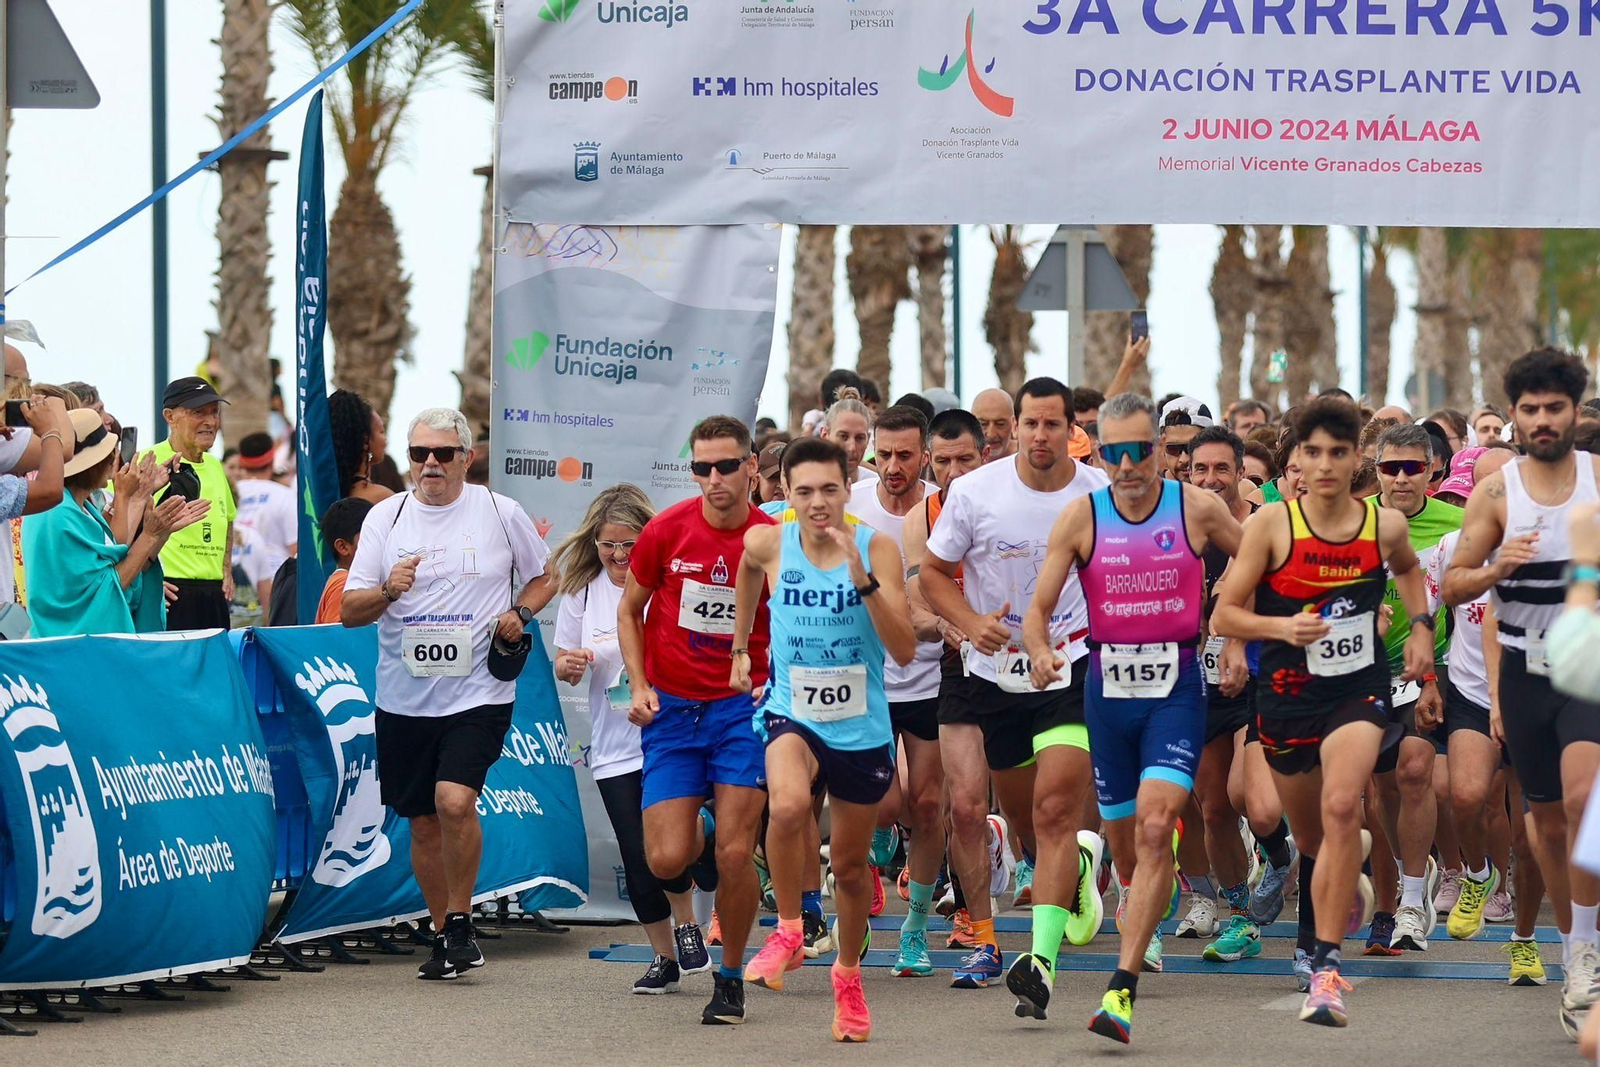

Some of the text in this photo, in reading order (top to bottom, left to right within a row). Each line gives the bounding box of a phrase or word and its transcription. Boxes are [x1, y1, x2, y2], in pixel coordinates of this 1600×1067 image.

[597, 0, 689, 28] Unicaja
[740, 5, 815, 14] Junta de Andalucía
[849, 9, 894, 17] FUNDACIÓN
[1141, 0, 1509, 36] CARRERA
[849, 16, 894, 30] persán
[549, 71, 595, 80] www.tiendas
[1074, 61, 1581, 95] DONACIÓN TRASPLANTE VIDA
[743, 77, 879, 101] hm hospitales
[949, 126, 991, 135] Asociación
[1163, 114, 1480, 143] 2 JUNIO 2024 MÁLAGA
[922, 139, 1019, 149] Donación Trasplante Vida
[610, 151, 684, 163] Ayuntamiento
[763, 152, 837, 161] Puerto de Málaga
[936, 151, 1004, 159] Vicente Granados
[610, 164, 664, 177] de Málaga
[1158, 155, 1483, 174] Memorial Vicente Granados Cabezas
[556, 333, 673, 362] Fundación
[554, 356, 638, 385] Unicaja
[693, 383, 731, 397] persán
[532, 411, 614, 428] hm hospitales
[506, 448, 549, 457] www.tiendas
[652, 460, 680, 472] Junta
[1303, 551, 1361, 568] Málaga
[1319, 565, 1361, 577] Bahía
[1105, 568, 1179, 594] BARRANQUERO
[783, 583, 862, 614] nerja
[693, 601, 736, 620] 425
[794, 615, 854, 627] ATLETISMO
[414, 644, 459, 662] 600
[1319, 634, 1364, 659] 368
[1109, 663, 1172, 682] 1157
[803, 684, 851, 705] 760
[511, 723, 545, 767] de
[92, 750, 224, 821] Ayuntamiento
[221, 743, 249, 794] de
[475, 784, 544, 819] e Deporte
[118, 835, 236, 891] Área de Deporte
